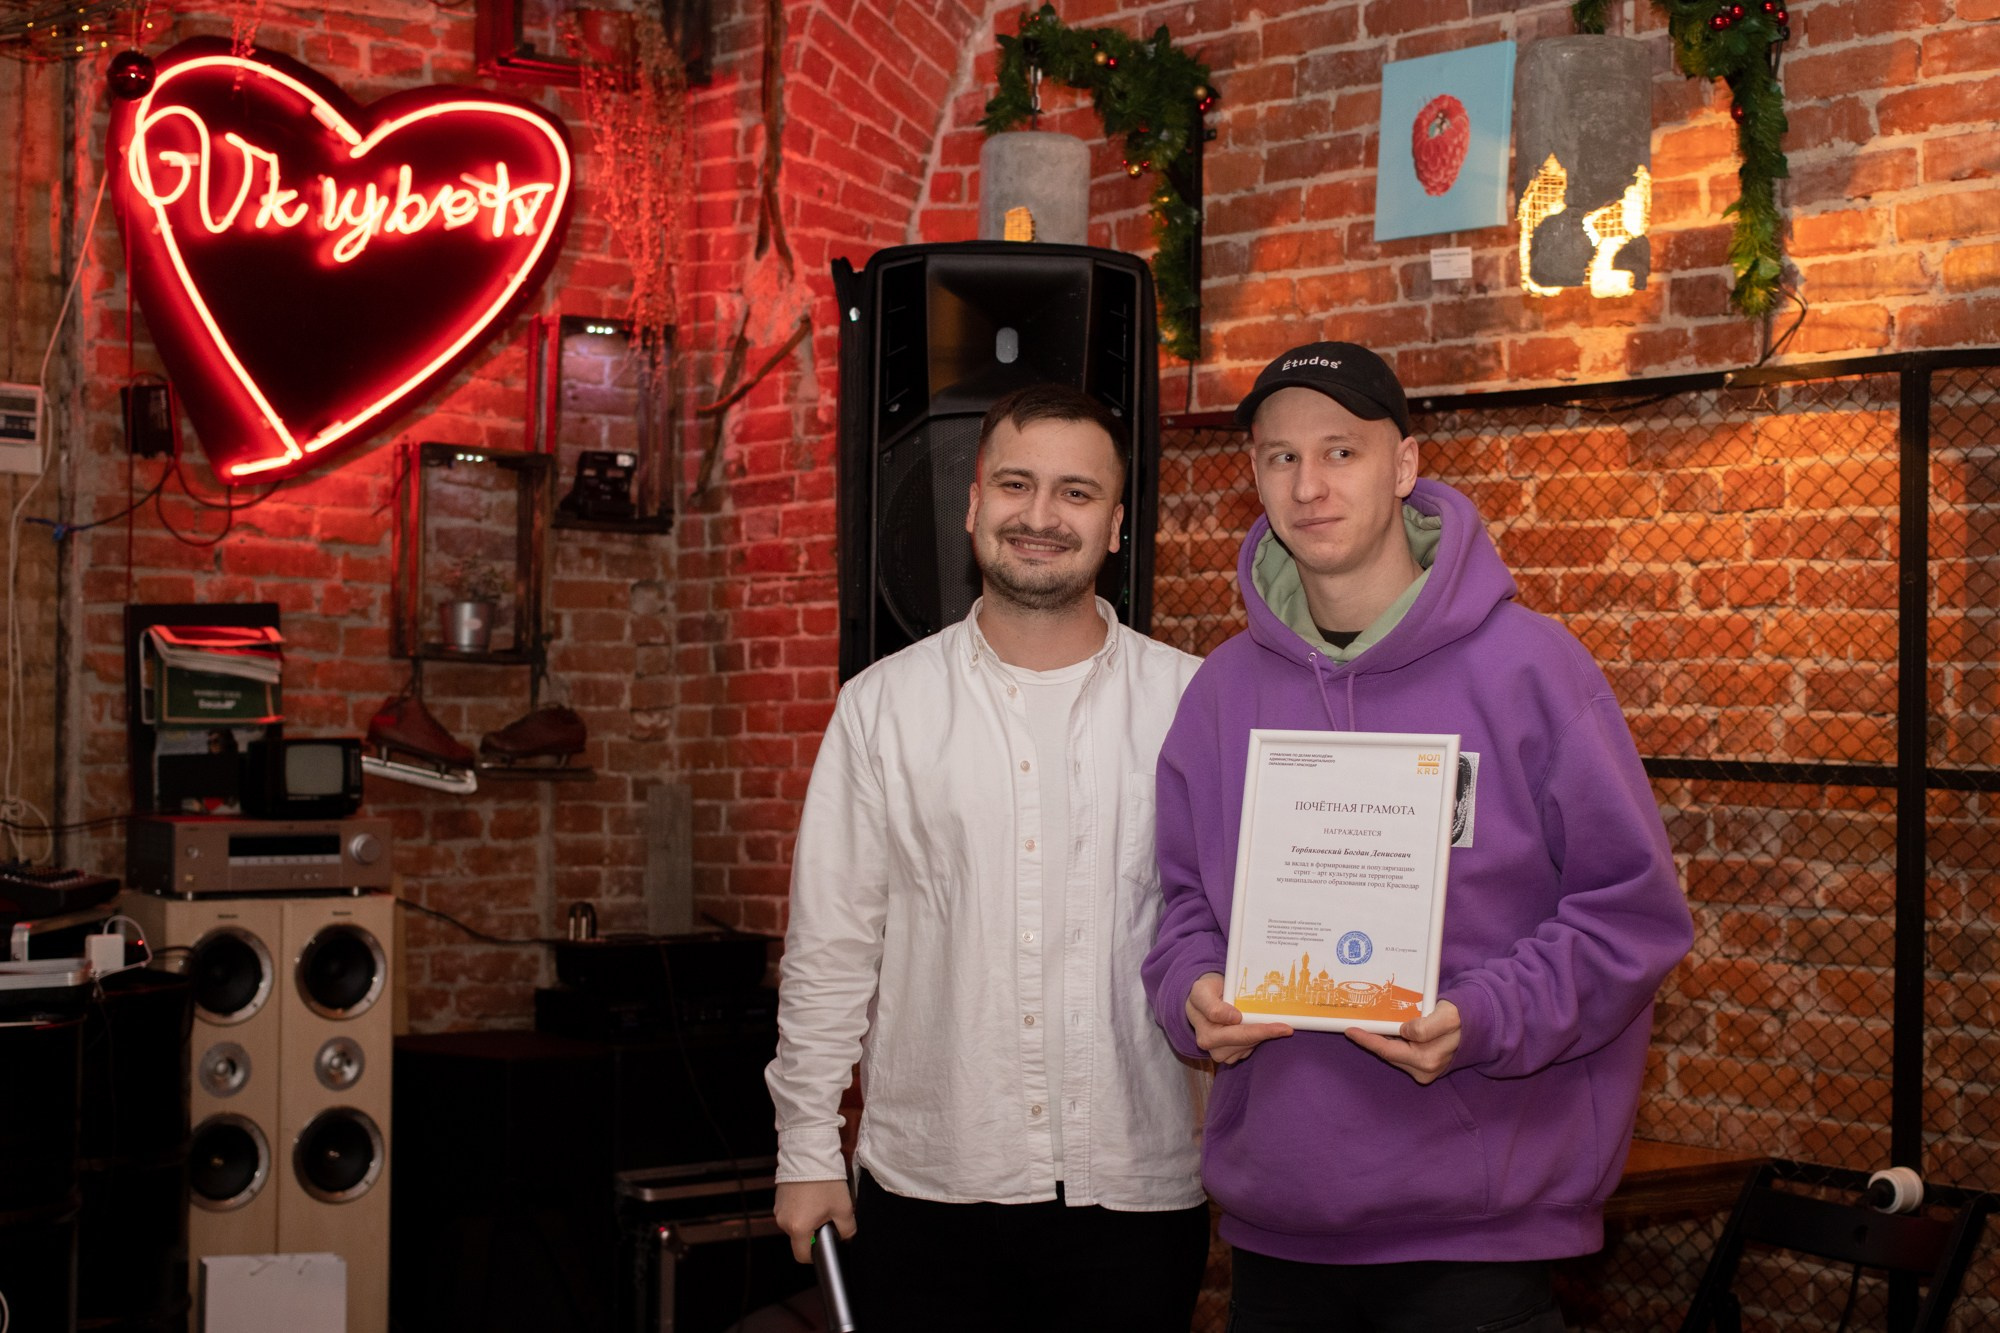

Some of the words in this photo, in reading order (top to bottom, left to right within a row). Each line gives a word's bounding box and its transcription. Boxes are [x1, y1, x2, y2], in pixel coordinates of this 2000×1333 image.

[1418, 753, 1441, 762] МОЛ
[1416, 767, 1439, 775] KRD
[1295, 800, 1358, 813] ПОЧЁТНАЯ
[1360, 803, 1416, 815] ГРАМОТА
[1323, 827, 1382, 837] НАГРАЖДАЕТСЯ
[1290, 845, 1342, 856] Торбяковский
[1343, 848, 1369, 857] Богдан
[1370, 849, 1412, 859] Денисович
[1315, 862, 1360, 870] формирование
[1366, 864, 1415, 872] популяризацию
[1328, 871, 1358, 879] культуры
[1368, 873, 1403, 882] территории
[1276, 877, 1327, 885] муниципального
[1328, 878, 1366, 887] образования
[1386, 881, 1420, 890] Краснодар
